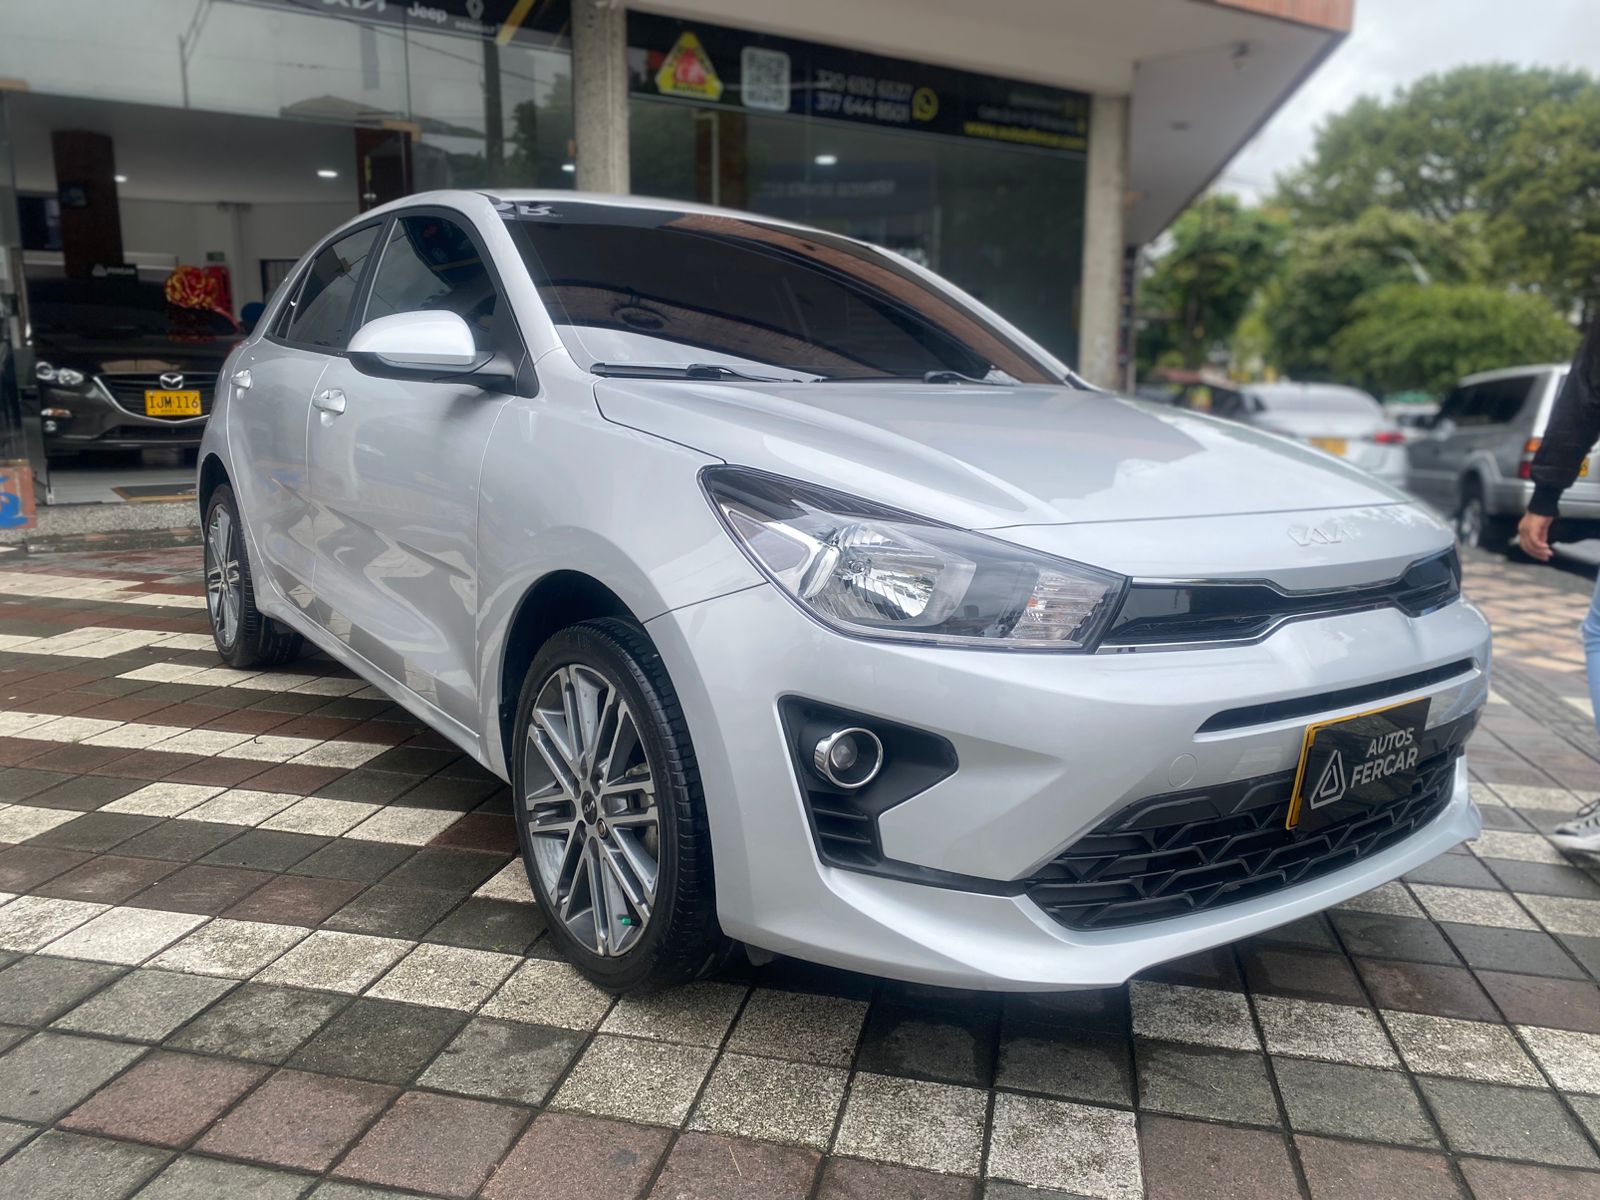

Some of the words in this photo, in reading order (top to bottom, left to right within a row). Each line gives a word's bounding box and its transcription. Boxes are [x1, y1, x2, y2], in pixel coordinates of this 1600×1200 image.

[407, 2, 447, 24] Jeep
[149, 395, 173, 409] IJM
[176, 395, 199, 409] 116
[1366, 727, 1415, 759] AUTOS
[1350, 747, 1419, 789] FERCAR
